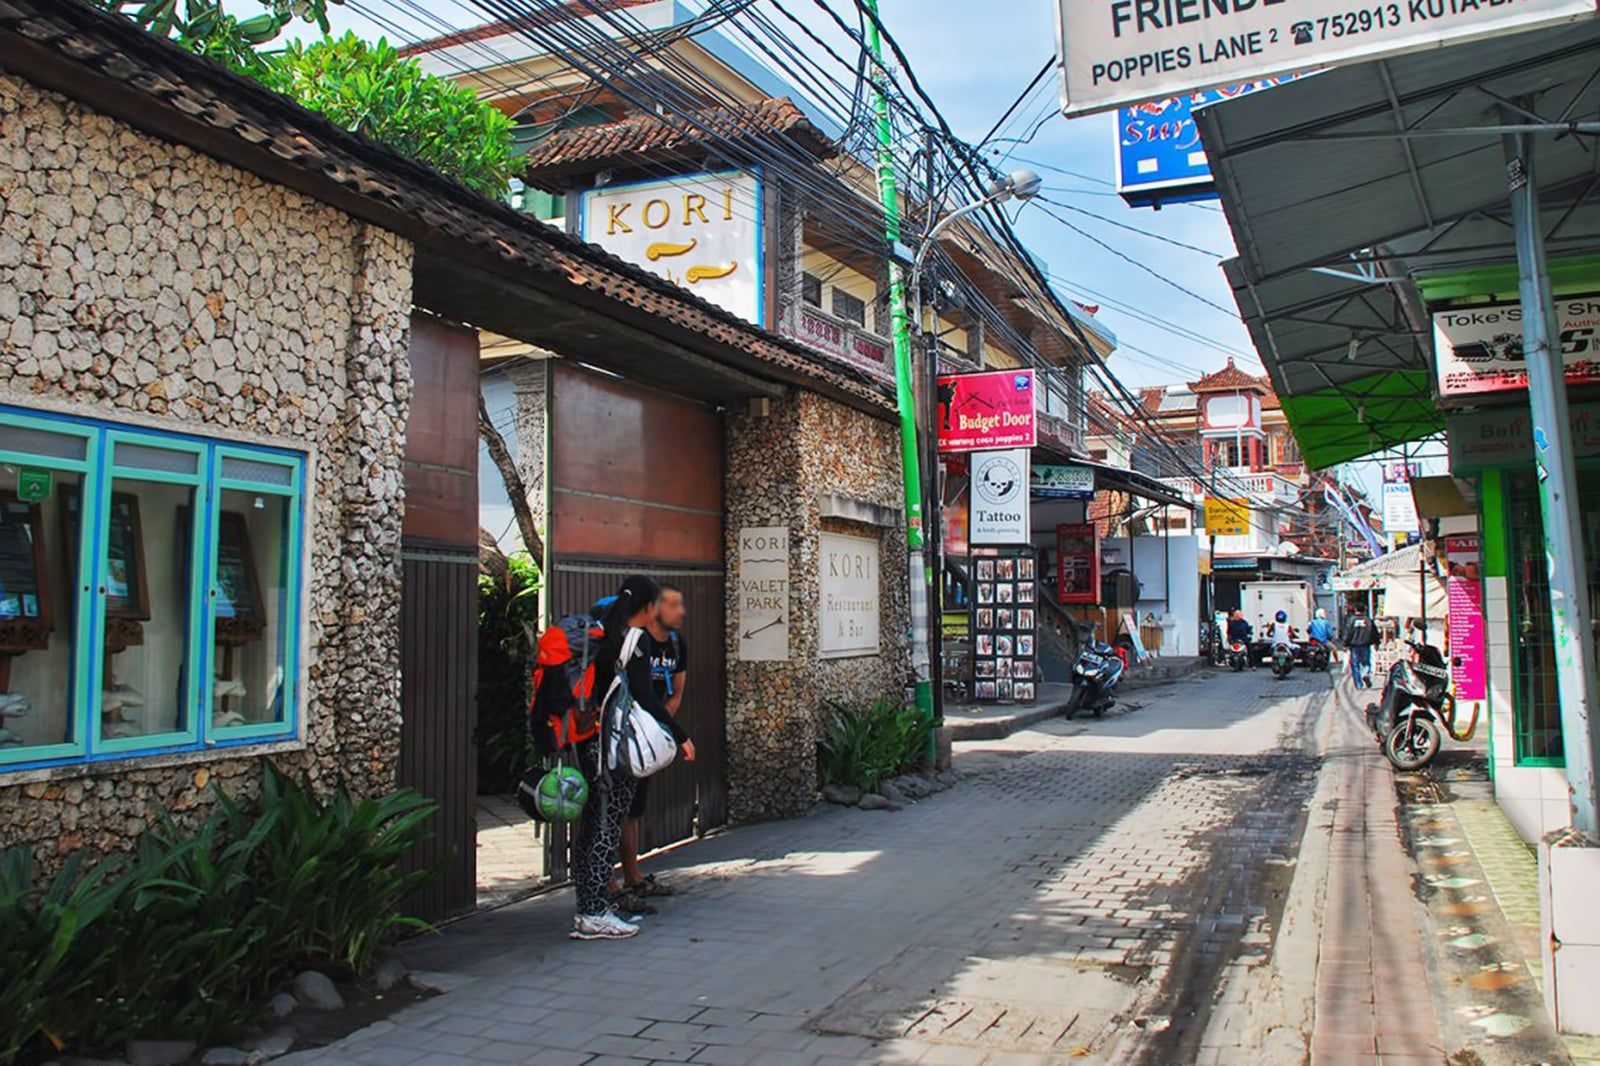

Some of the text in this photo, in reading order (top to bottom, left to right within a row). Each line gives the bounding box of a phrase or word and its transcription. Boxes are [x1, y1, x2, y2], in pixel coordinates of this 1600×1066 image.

[1091, 46, 1192, 86] POPPIES
[1198, 31, 1263, 65] LANE
[1269, 28, 1278, 43] 2
[1317, 3, 1401, 41] 752913
[607, 188, 733, 235] KORI
[960, 411, 1031, 433] Budget Door
[976, 510, 1021, 522] Tattoo
[742, 537, 786, 550] KORI
[829, 553, 871, 579] KORI
[741, 580, 787, 593] VALET
[745, 597, 783, 609] PARK
[827, 593, 873, 612] Restaurant
[849, 620, 864, 637] Bar
